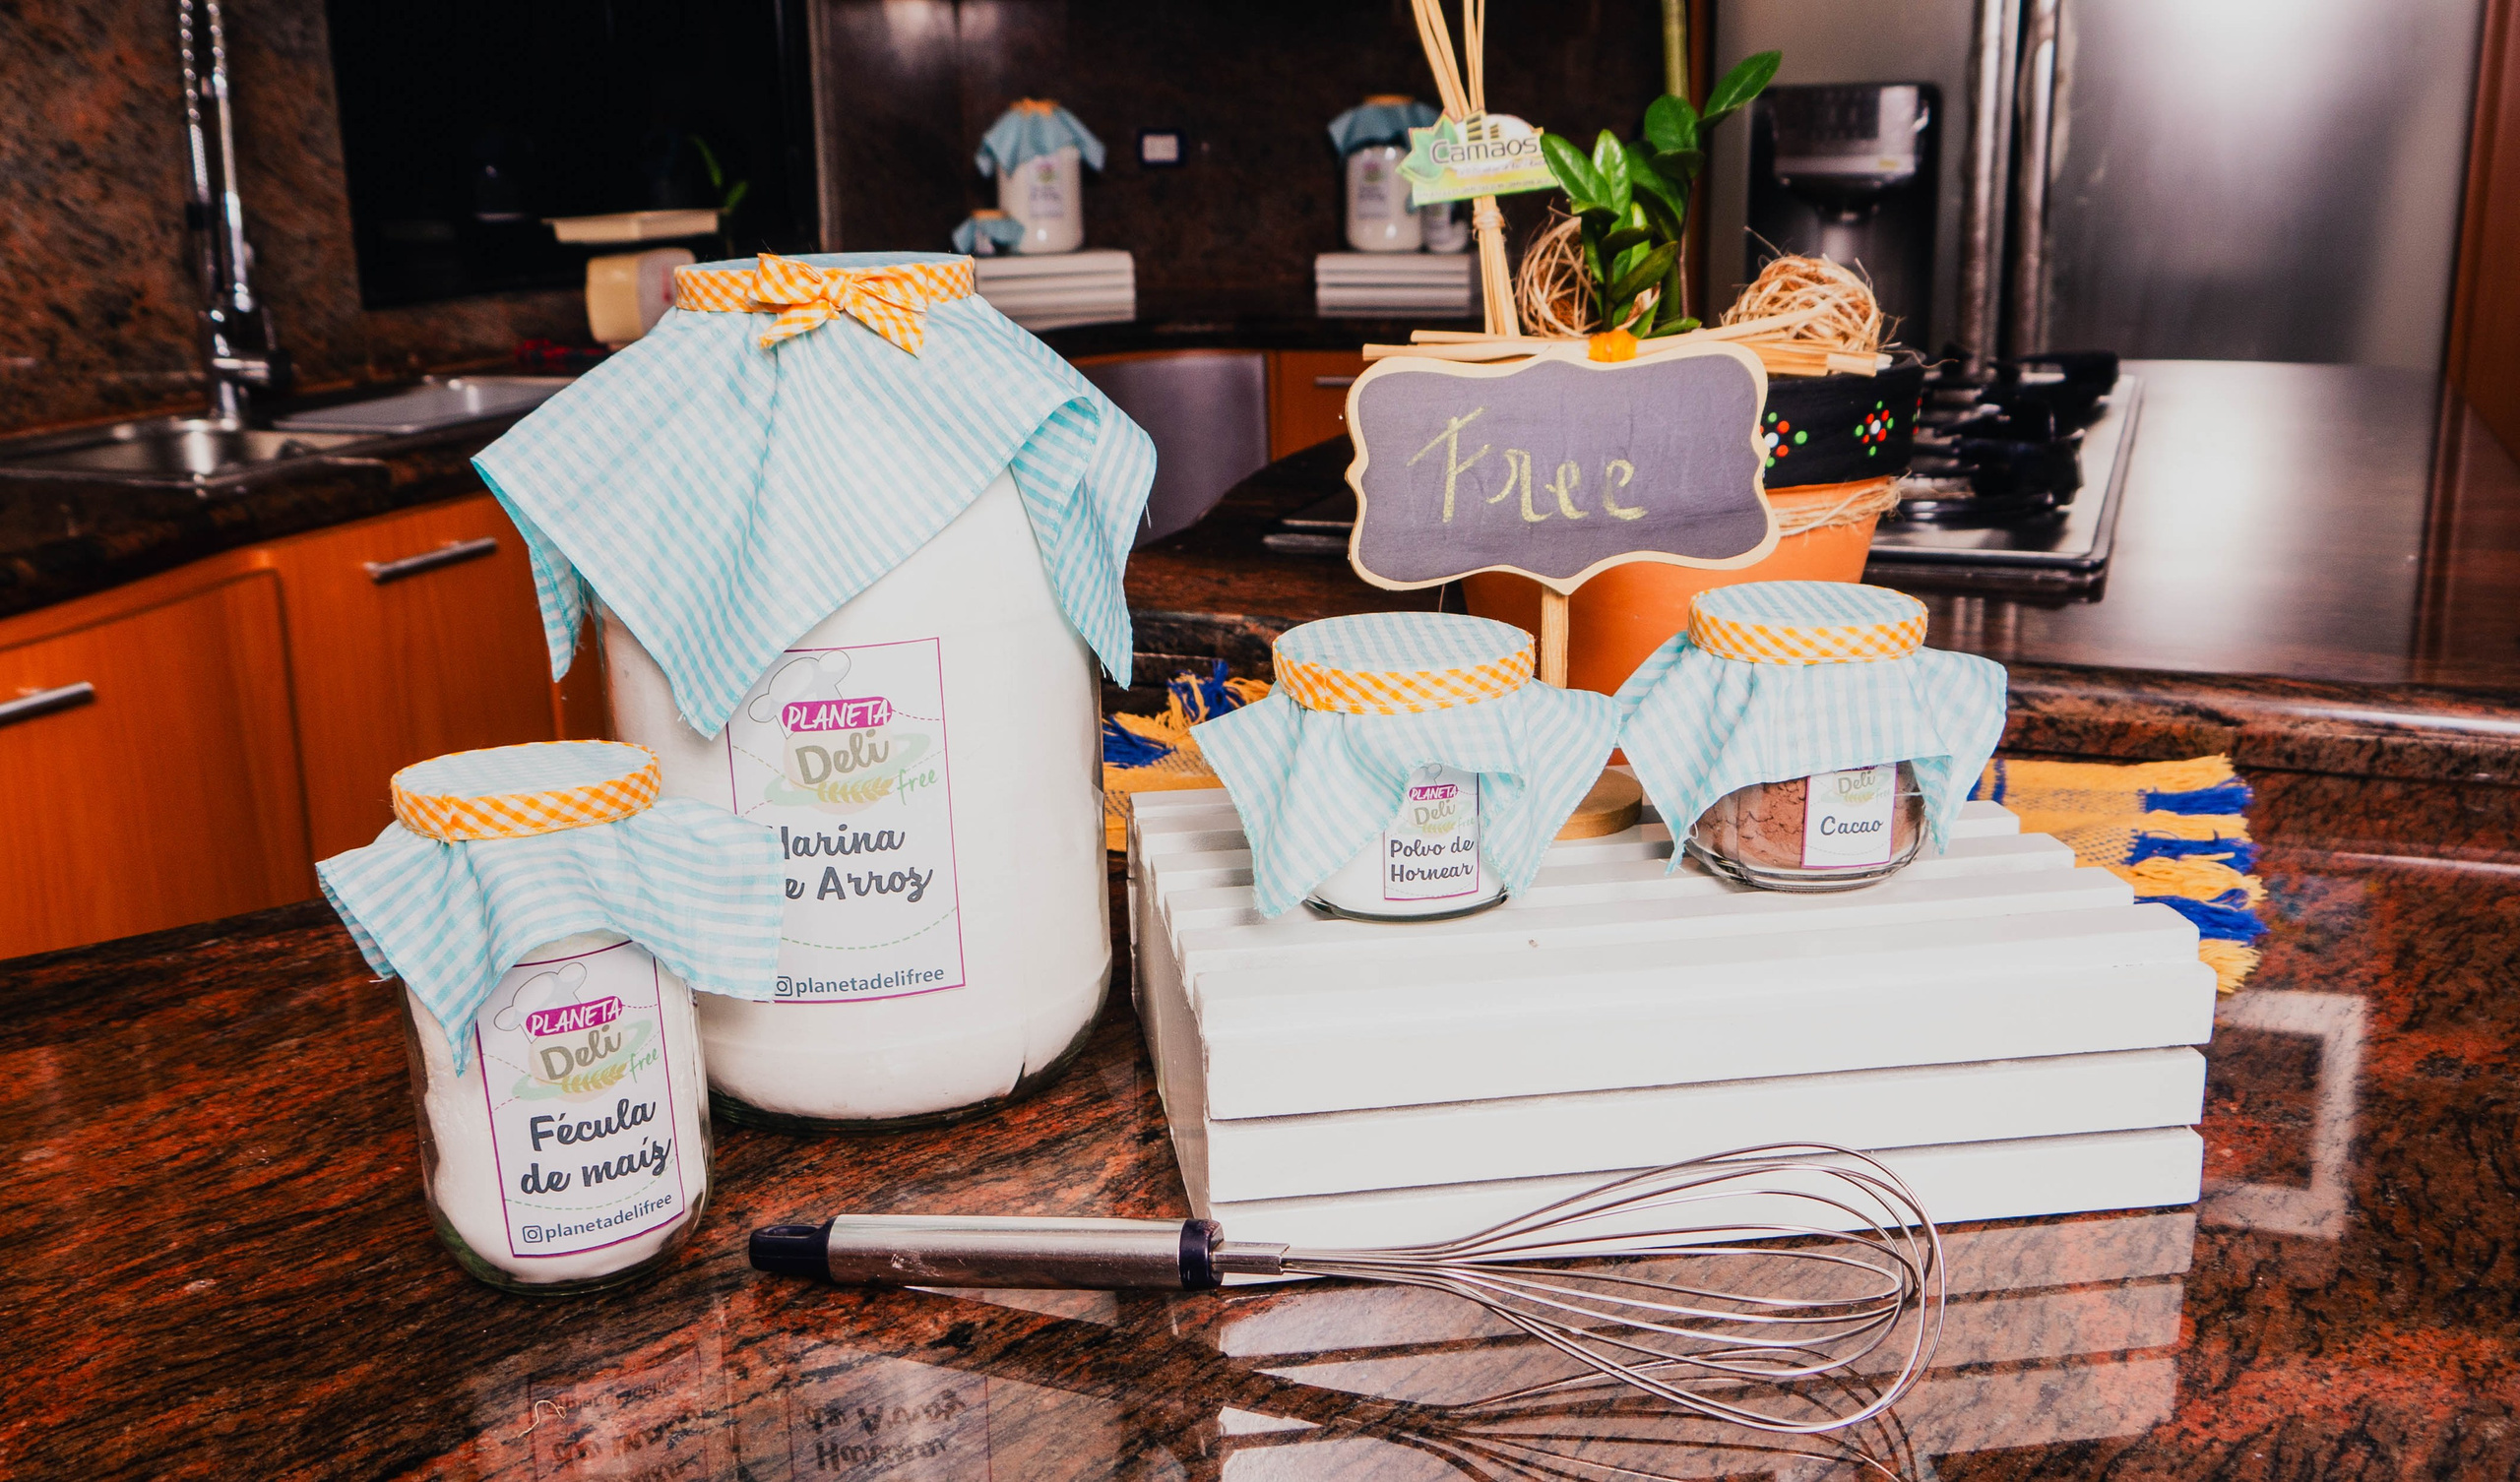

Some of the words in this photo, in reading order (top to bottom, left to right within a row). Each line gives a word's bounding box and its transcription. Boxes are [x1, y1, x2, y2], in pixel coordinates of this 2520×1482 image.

[1431, 136, 1538, 164] Camaos
[1407, 405, 1649, 524] Free
[787, 699, 892, 731] PLANETA
[795, 728, 890, 785] Deli
[897, 768, 938, 805] free
[1411, 785, 1458, 800] PLANETA
[1838, 771, 1875, 794] Deli
[1414, 799, 1456, 826] Deli
[1820, 815, 1884, 836] Cacao
[1390, 838, 1445, 858] Polvo
[1450, 835, 1475, 853] de
[785, 878, 805, 899] e
[817, 866, 933, 902] Arroz
[1391, 863, 1475, 883] Hornear
[795, 967, 945, 997] planetadelifree
[530, 997, 622, 1034] PLANETA
[539, 1024, 622, 1081] Deli
[629, 1047, 660, 1083] free
[530, 1098, 657, 1152] Fécula
[521, 1163, 571, 1195] de
[581, 1136, 672, 1187] maíz
[545, 1194, 673, 1243] planetadelifree
